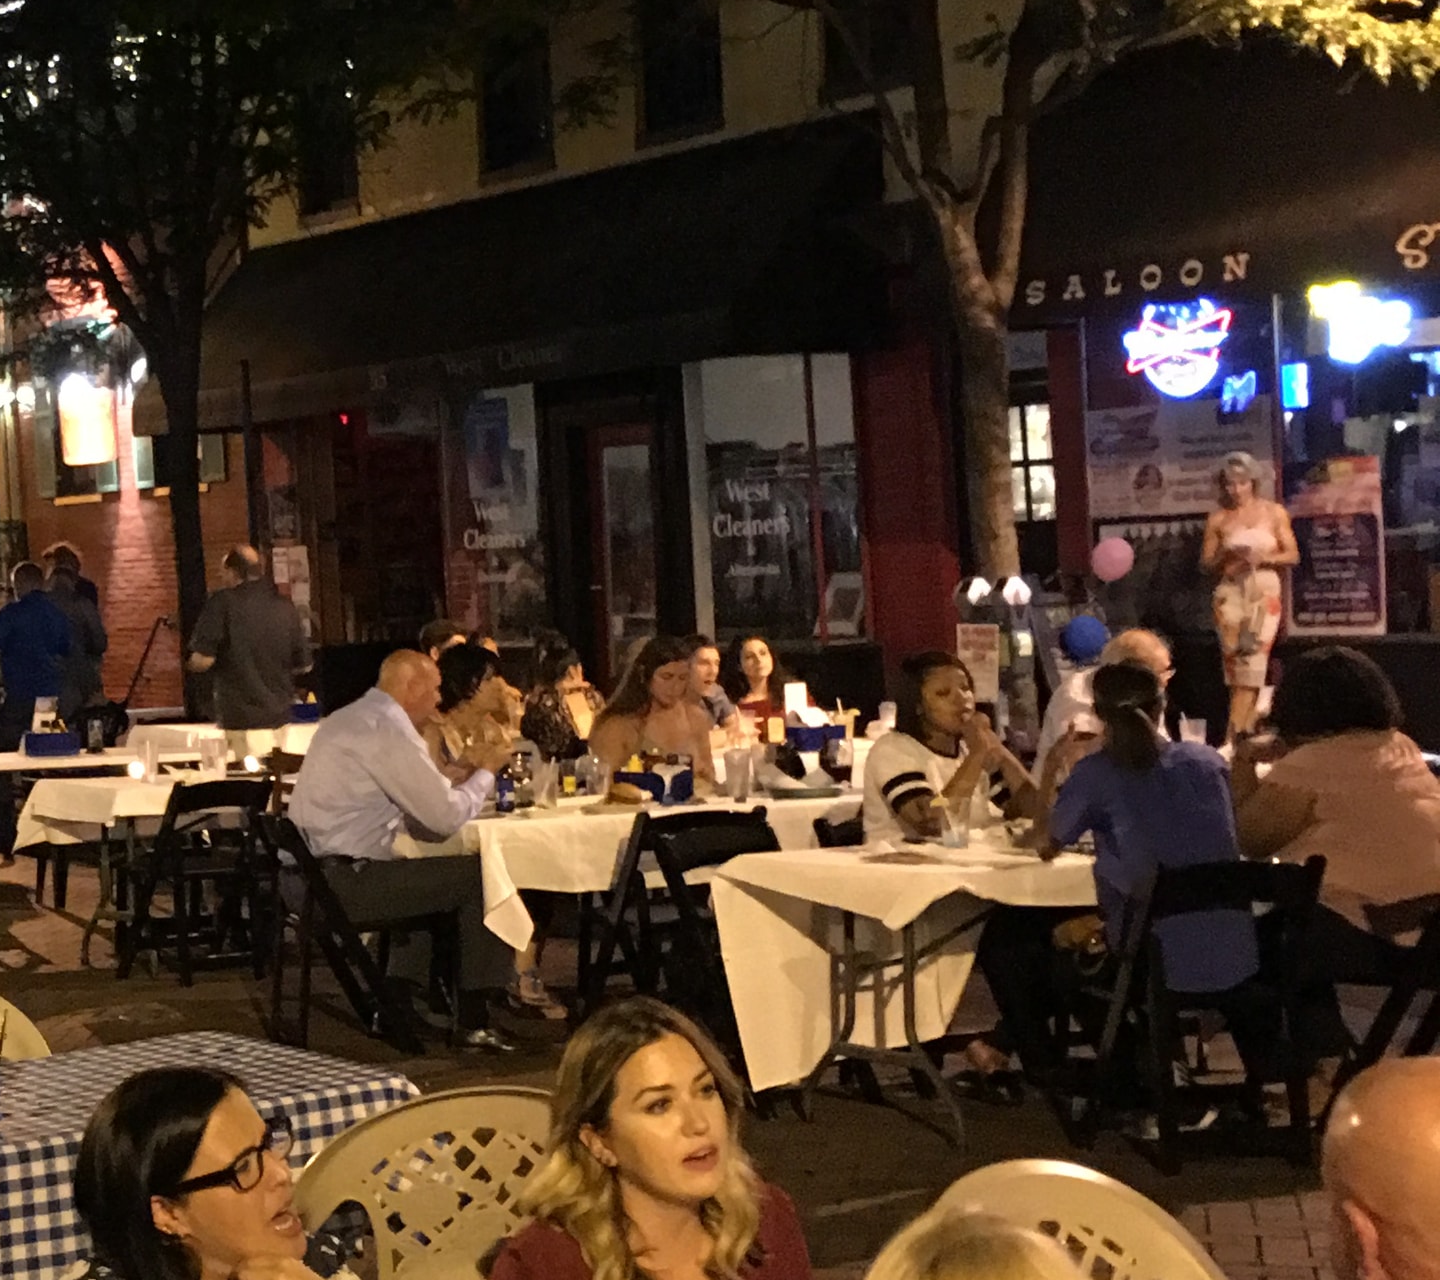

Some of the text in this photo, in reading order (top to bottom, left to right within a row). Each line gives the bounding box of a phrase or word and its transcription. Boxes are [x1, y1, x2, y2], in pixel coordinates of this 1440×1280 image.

[1025, 251, 1251, 304] SALOON
[725, 479, 770, 502] West
[473, 500, 509, 522] West
[713, 513, 790, 538] Cleaners
[463, 528, 526, 550] Cleaners
